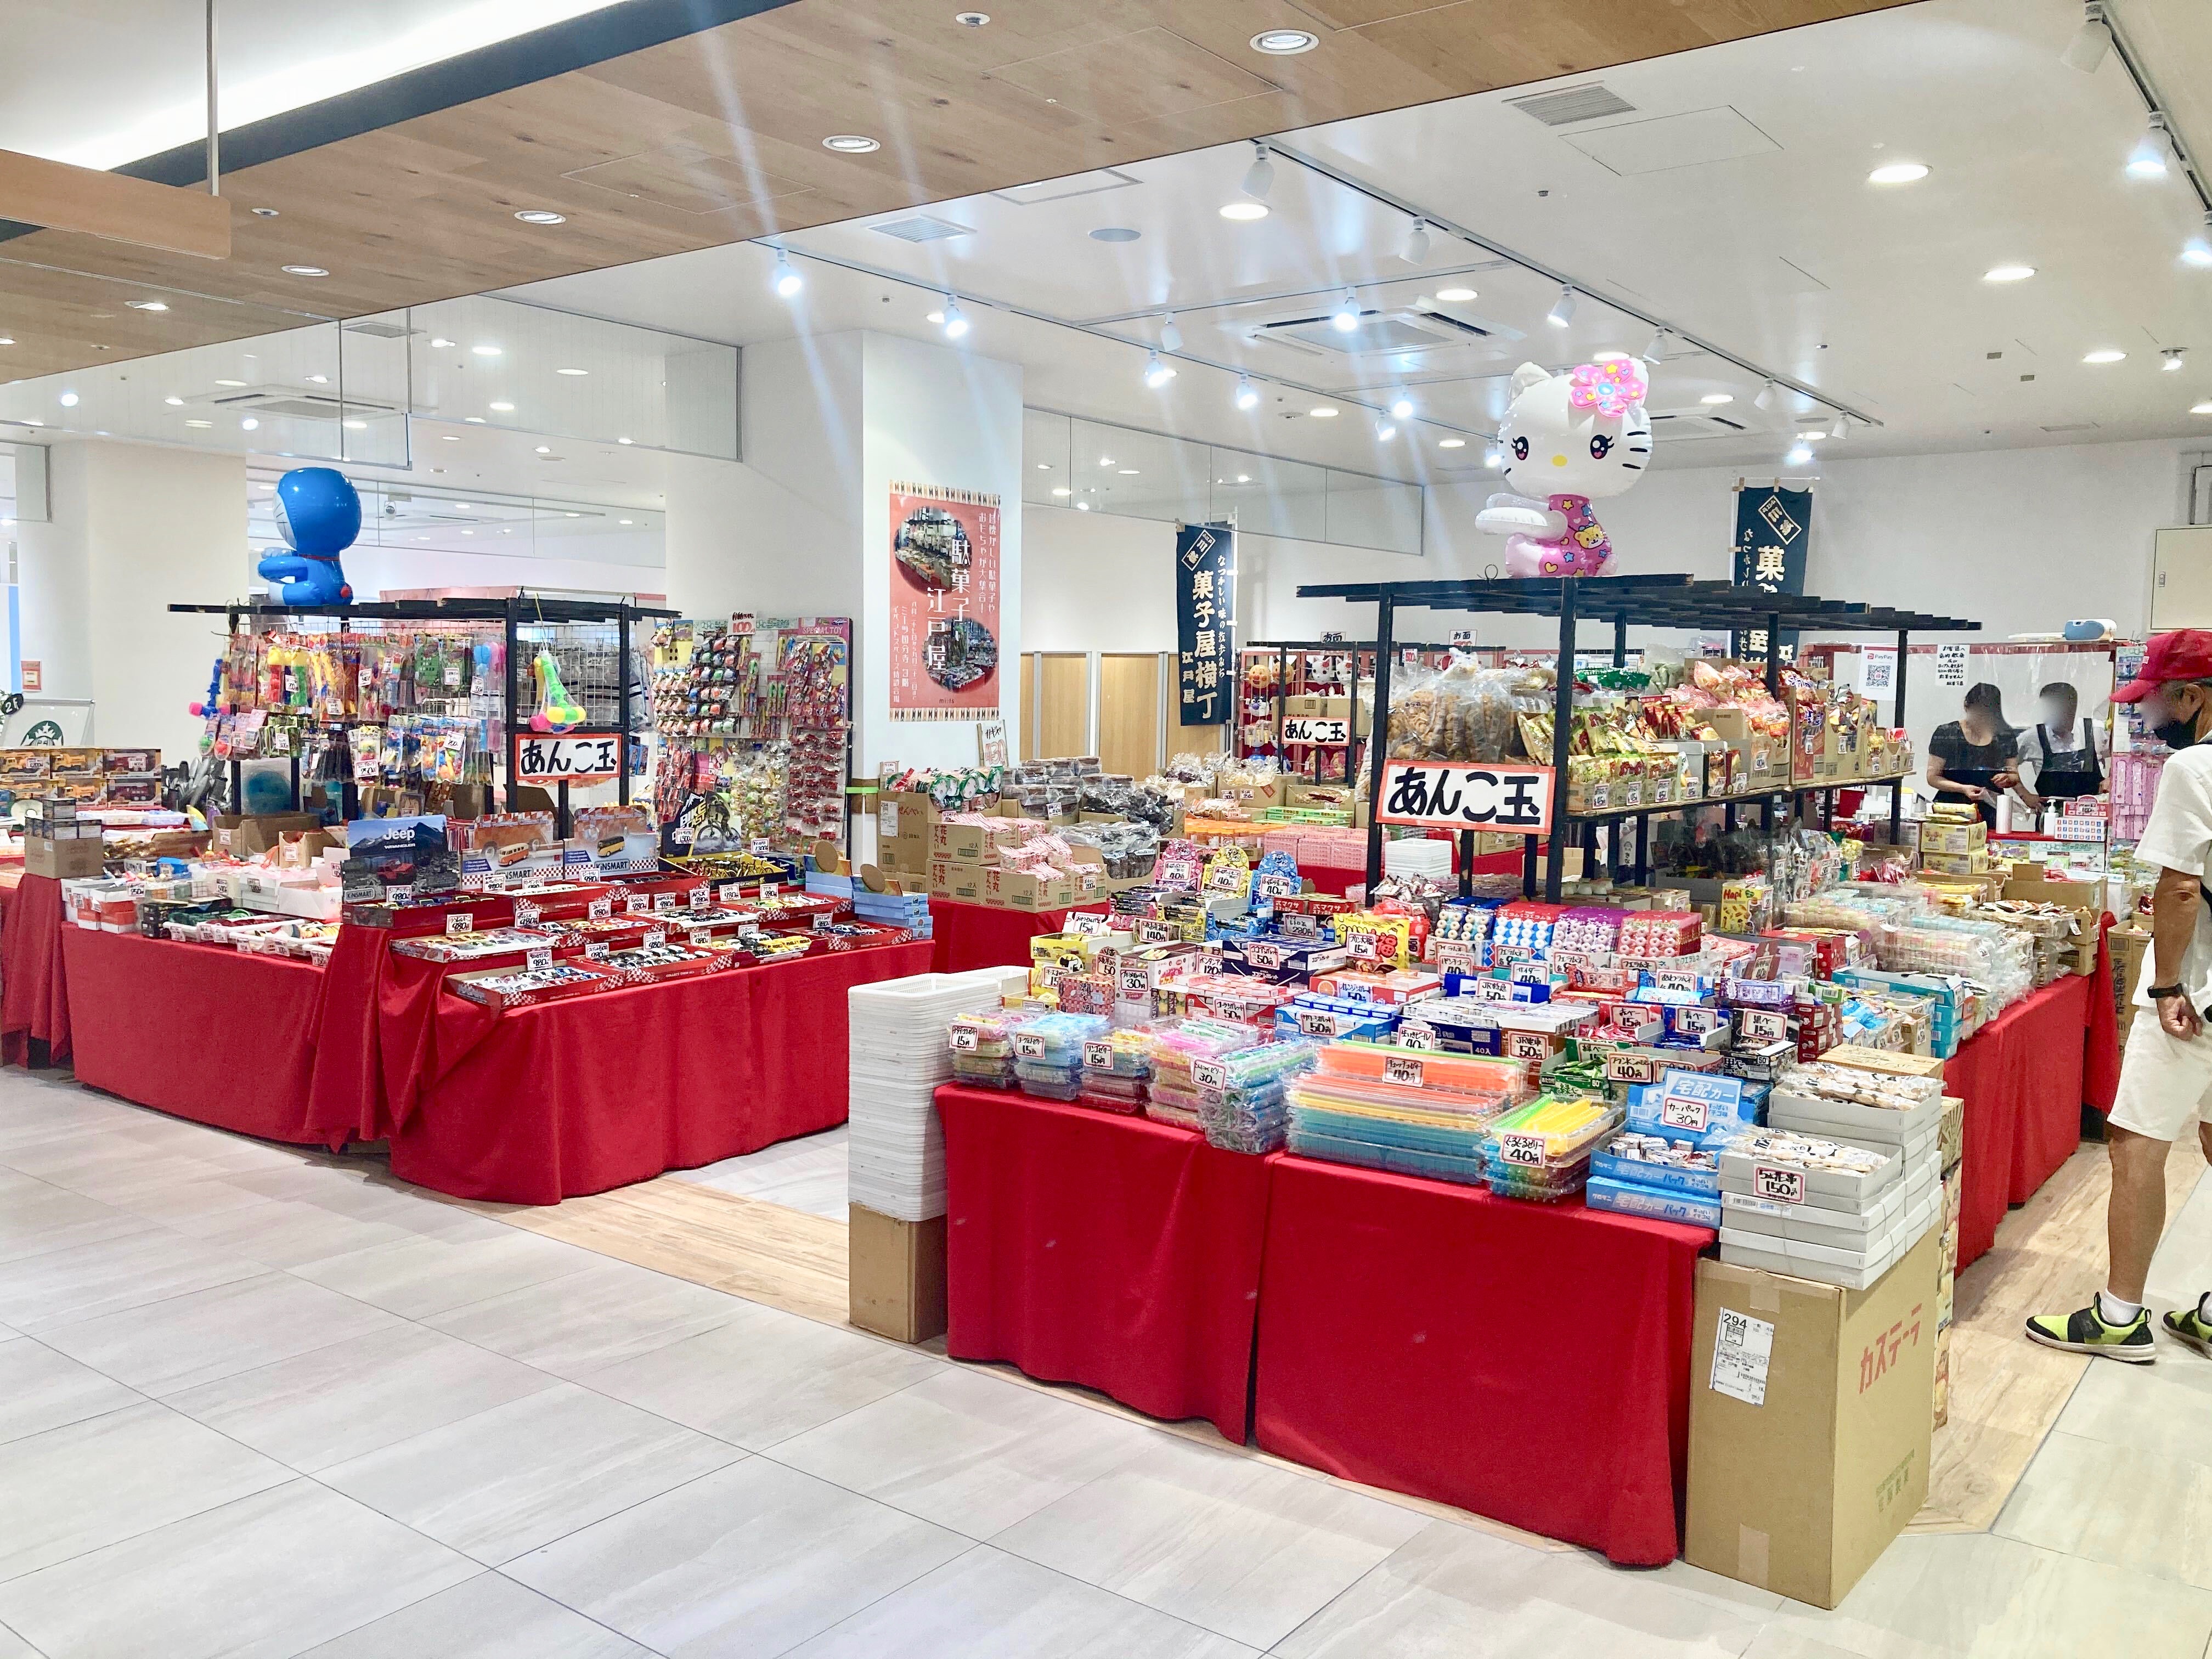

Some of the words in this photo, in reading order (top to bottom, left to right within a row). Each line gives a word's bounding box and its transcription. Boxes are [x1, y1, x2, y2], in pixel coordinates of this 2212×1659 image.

[926, 586, 947, 672] 江戸屋
[1453, 631, 1471, 640] お面
[1192, 570, 1218, 720] 菓子屋横丁
[1181, 651, 1195, 704] 江戸屋
[5, 697, 20, 713] 2F
[1285, 719, 1346, 743] あんこ玉
[521, 740, 617, 775] あんこ玉
[1387, 767, 1541, 826] あんこ玉
[680, 801, 707, 827] BIKE
[898, 806, 924, 816] せんべい
[383, 828, 415, 842] Jeep
[939, 824, 947, 847] 花丸
[938, 864, 946, 885] 花丸
[992, 870, 1000, 893] 花丸
[1217, 877, 1233, 887] 40円
[1267, 884, 1283, 896] 40円
[1079, 922, 1094, 934] 15円
[1146, 931, 1166, 942] 140円
[1354, 944, 1368, 955] 15円
[1256, 955, 1273, 966] 50円
[1517, 966, 1542, 975] サイダー
[1126, 978, 1146, 990] 30円
[1481, 981, 1507, 992] JR特急
[1223, 1009, 1241, 1020] 50円
[1310, 1023, 1331, 1034] 50円
[1622, 1017, 1641, 1028] 15円
[1686, 1020, 1706, 1033] 15円
[1753, 1024, 1774, 1037] 15円
[957, 1036, 970, 1046] 15円
[1516, 1036, 1542, 1047] JR電車
[1022, 1045, 1037, 1054] 15円
[1475, 1047, 1491, 1056] 40入
[1519, 1045, 1543, 1060] 50円
[1091, 1054, 1105, 1064] 15円
[1198, 1072, 1217, 1086] 30円
[1392, 1068, 1416, 1083] 40円
[1617, 1066, 1643, 1079] 40円
[1592, 1079, 1600, 1087] 50
[1675, 1079, 1735, 1100] 宅配カー
[1667, 1102, 1701, 1114] カーパック
[1676, 1113, 1699, 1127] 30円
[1509, 1148, 1539, 1164] 40円
[1615, 1161, 1663, 1181] 宅配カー
[1663, 1173, 1685, 1186] パック
[1765, 1181, 1798, 1197] 150円
[1613, 1193, 1664, 1212] 宅配カー
[1664, 1204, 1687, 1217] パック
[1723, 1313, 1747, 1329] 294
[1859, 1302, 1923, 1395] カステーラ
